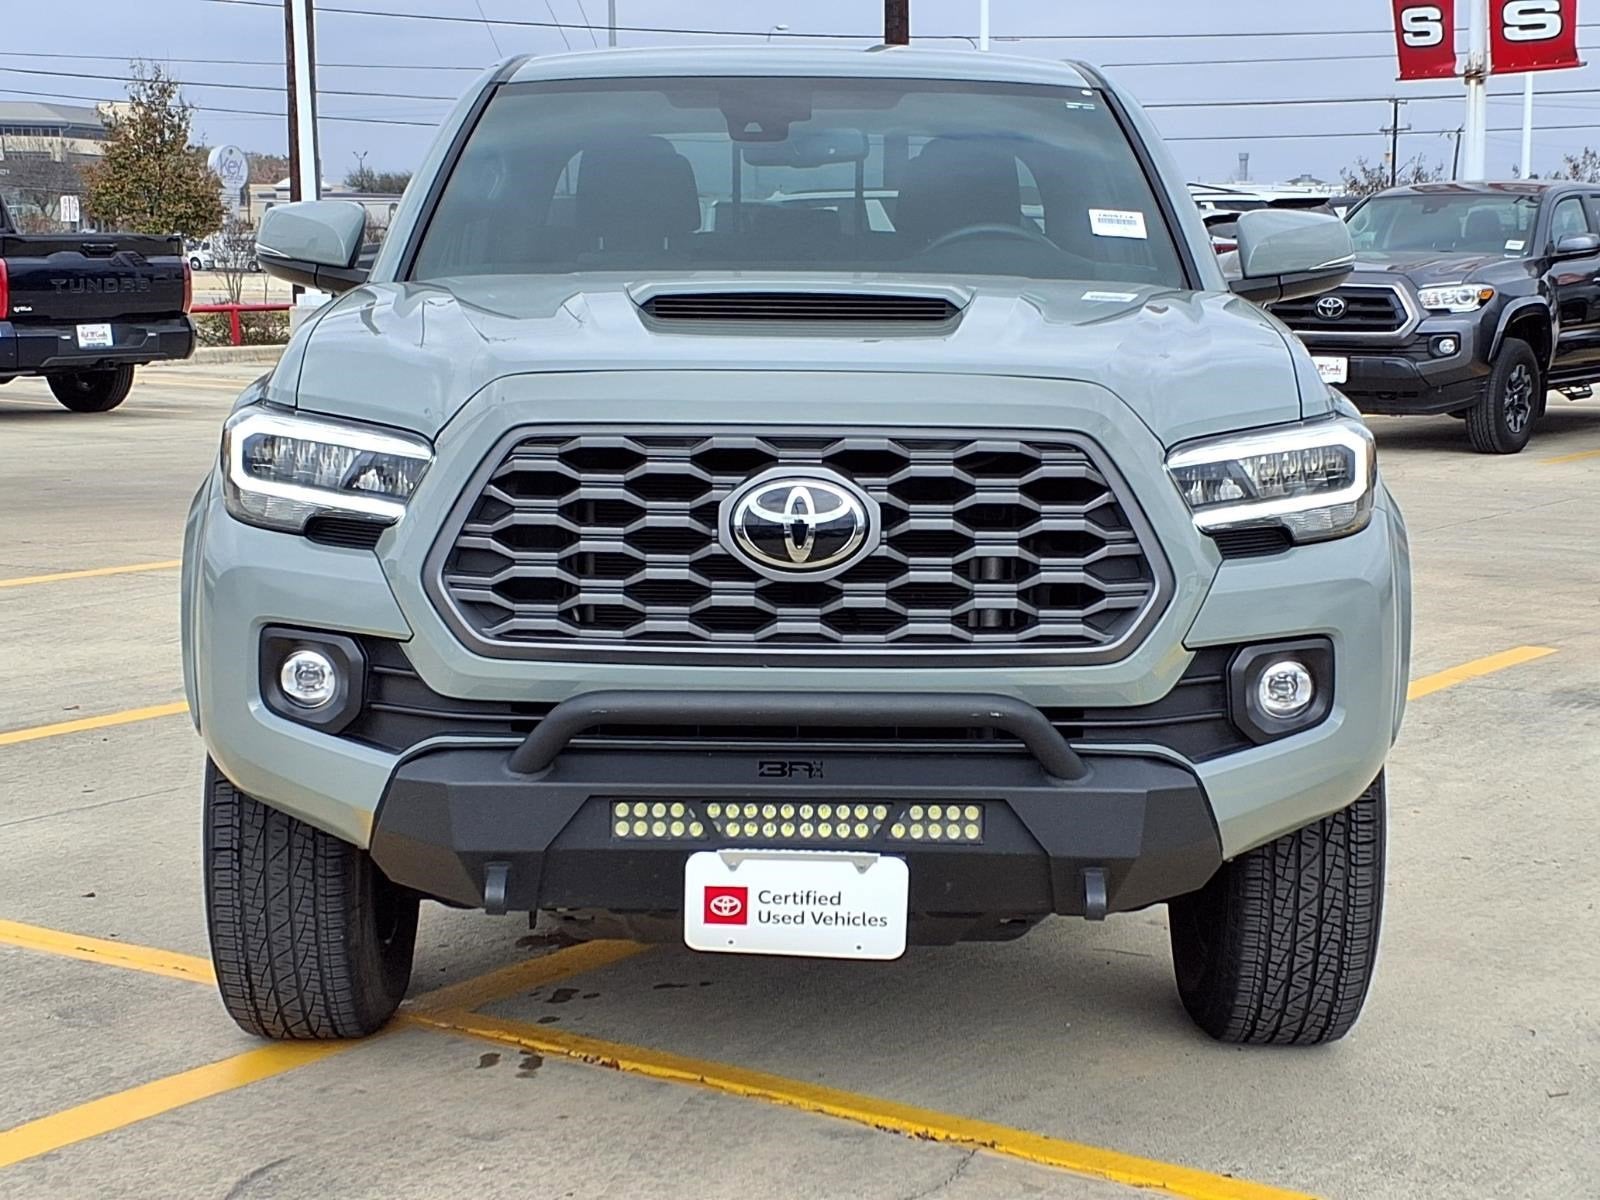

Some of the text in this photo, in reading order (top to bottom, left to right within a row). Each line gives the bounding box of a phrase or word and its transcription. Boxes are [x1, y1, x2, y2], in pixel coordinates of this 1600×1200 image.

[1401, 6, 1443, 47] S
[1502, 0, 1562, 42] S
[50, 277, 151, 294] TUNDRA
[758, 889, 842, 906] Certified
[758, 910, 888, 928] Used Vehicles
